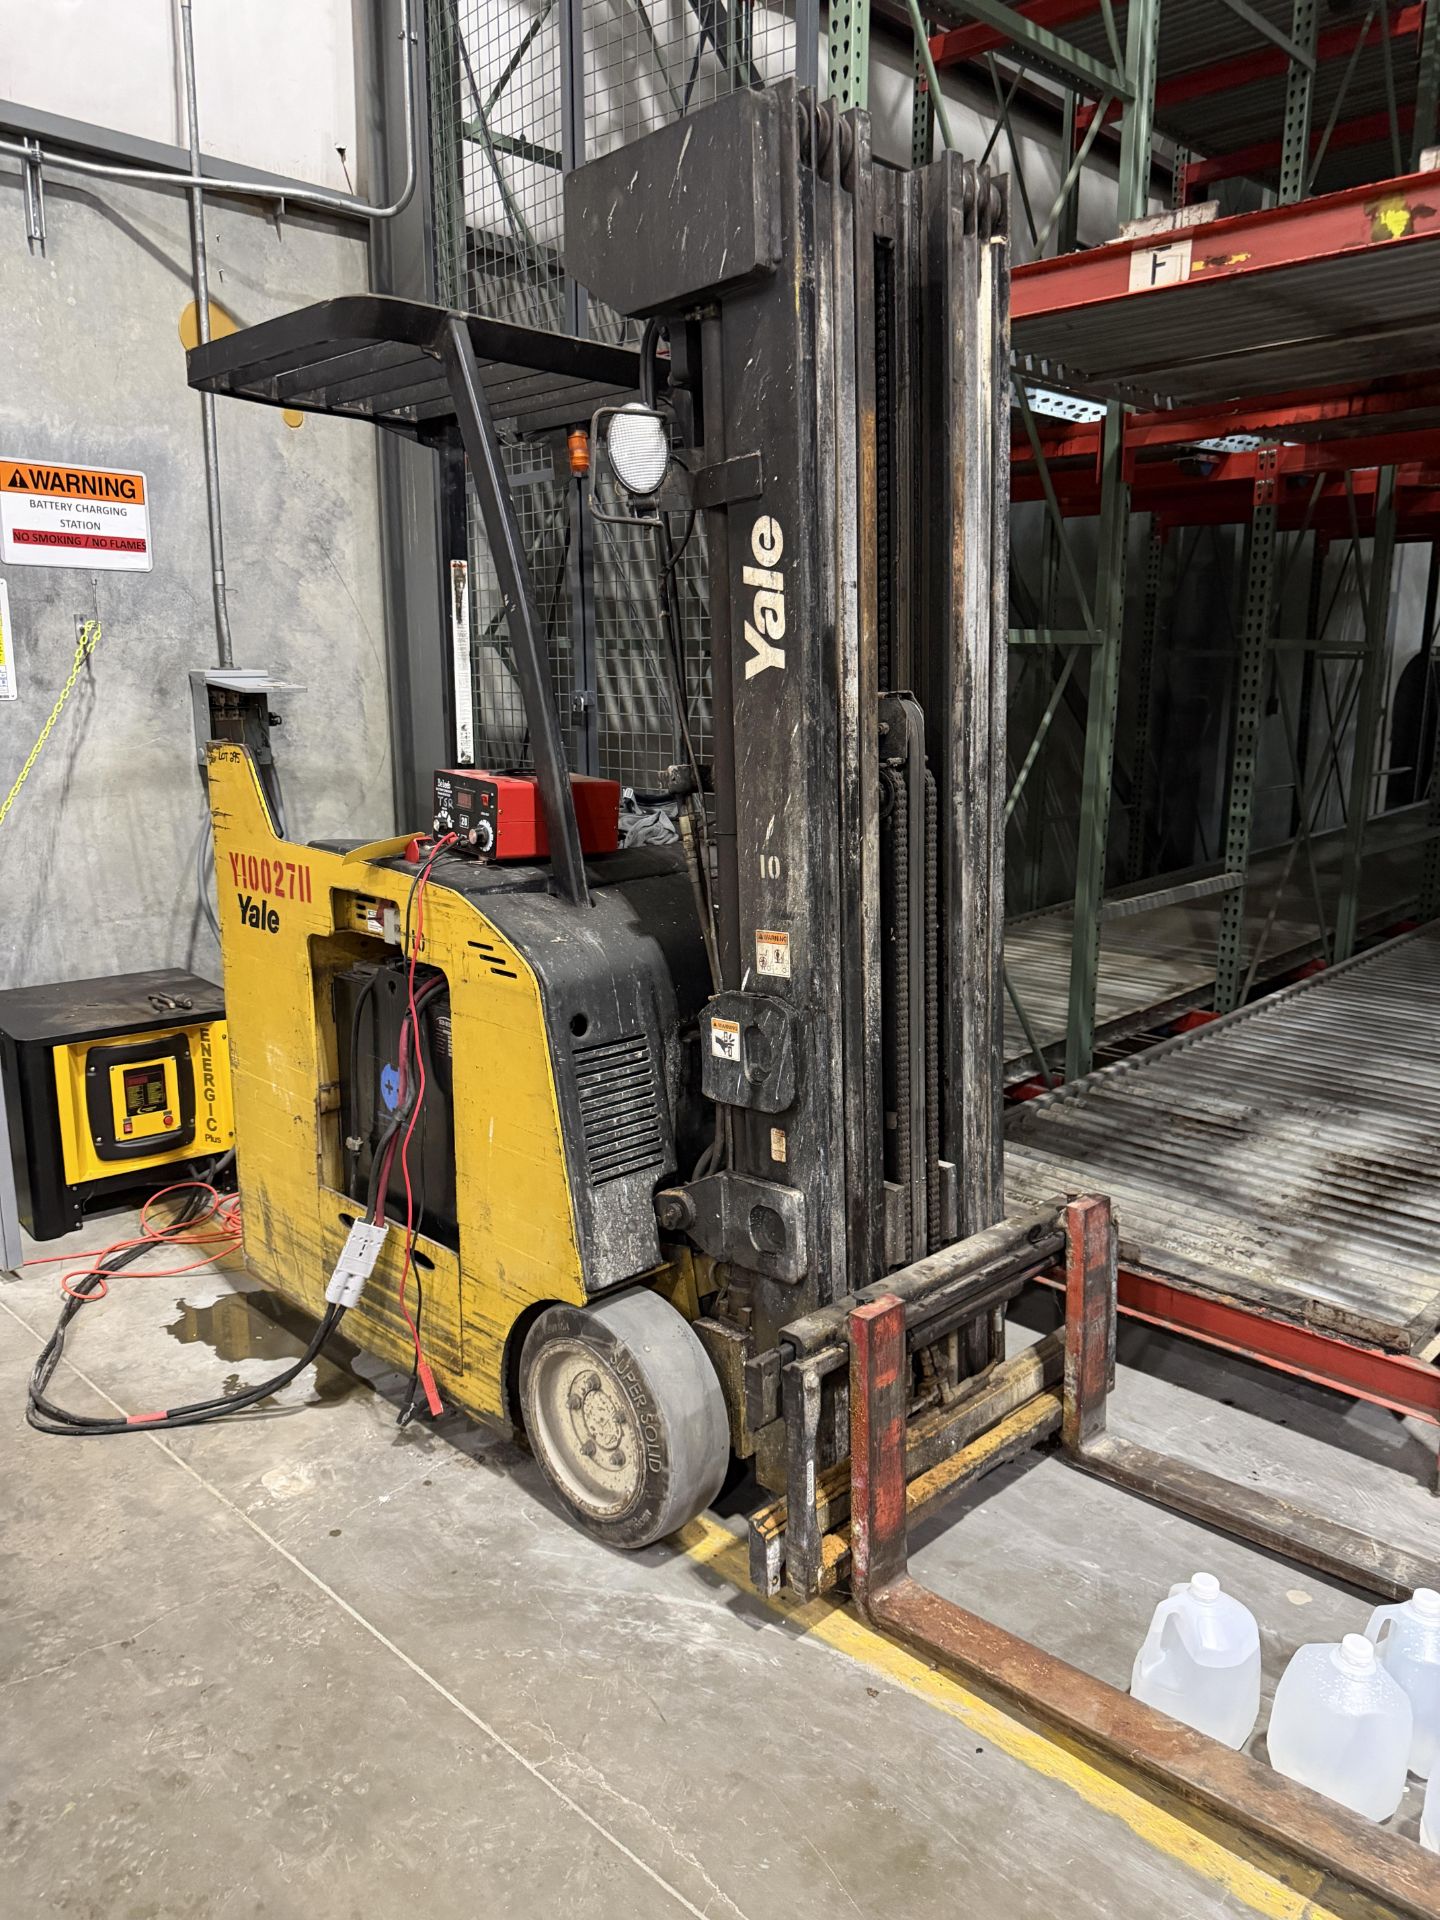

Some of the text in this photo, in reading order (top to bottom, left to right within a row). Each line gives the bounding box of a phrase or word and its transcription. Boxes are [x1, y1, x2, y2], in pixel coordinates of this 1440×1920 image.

[1151, 244, 1172, 285] F
[28, 468, 136, 499] WARNING
[29, 499, 128, 517] BATTERY CHARGING
[60, 519, 101, 531] STATION
[13, 532, 30, 541] NO
[32, 533, 82, 545] SMOKING
[92, 539, 108, 548] NO
[110, 540, 146, 551] FLAMES
[743, 515, 785, 680] Yale
[760, 854, 781, 880] 10
[238, 894, 280, 934] Yale
[200, 1028, 217, 1131] ENERGIC
[205, 1134, 221, 1143] Plus
[610, 1352, 646, 1407] SUPER
[640, 1413, 662, 1473] SOLID
